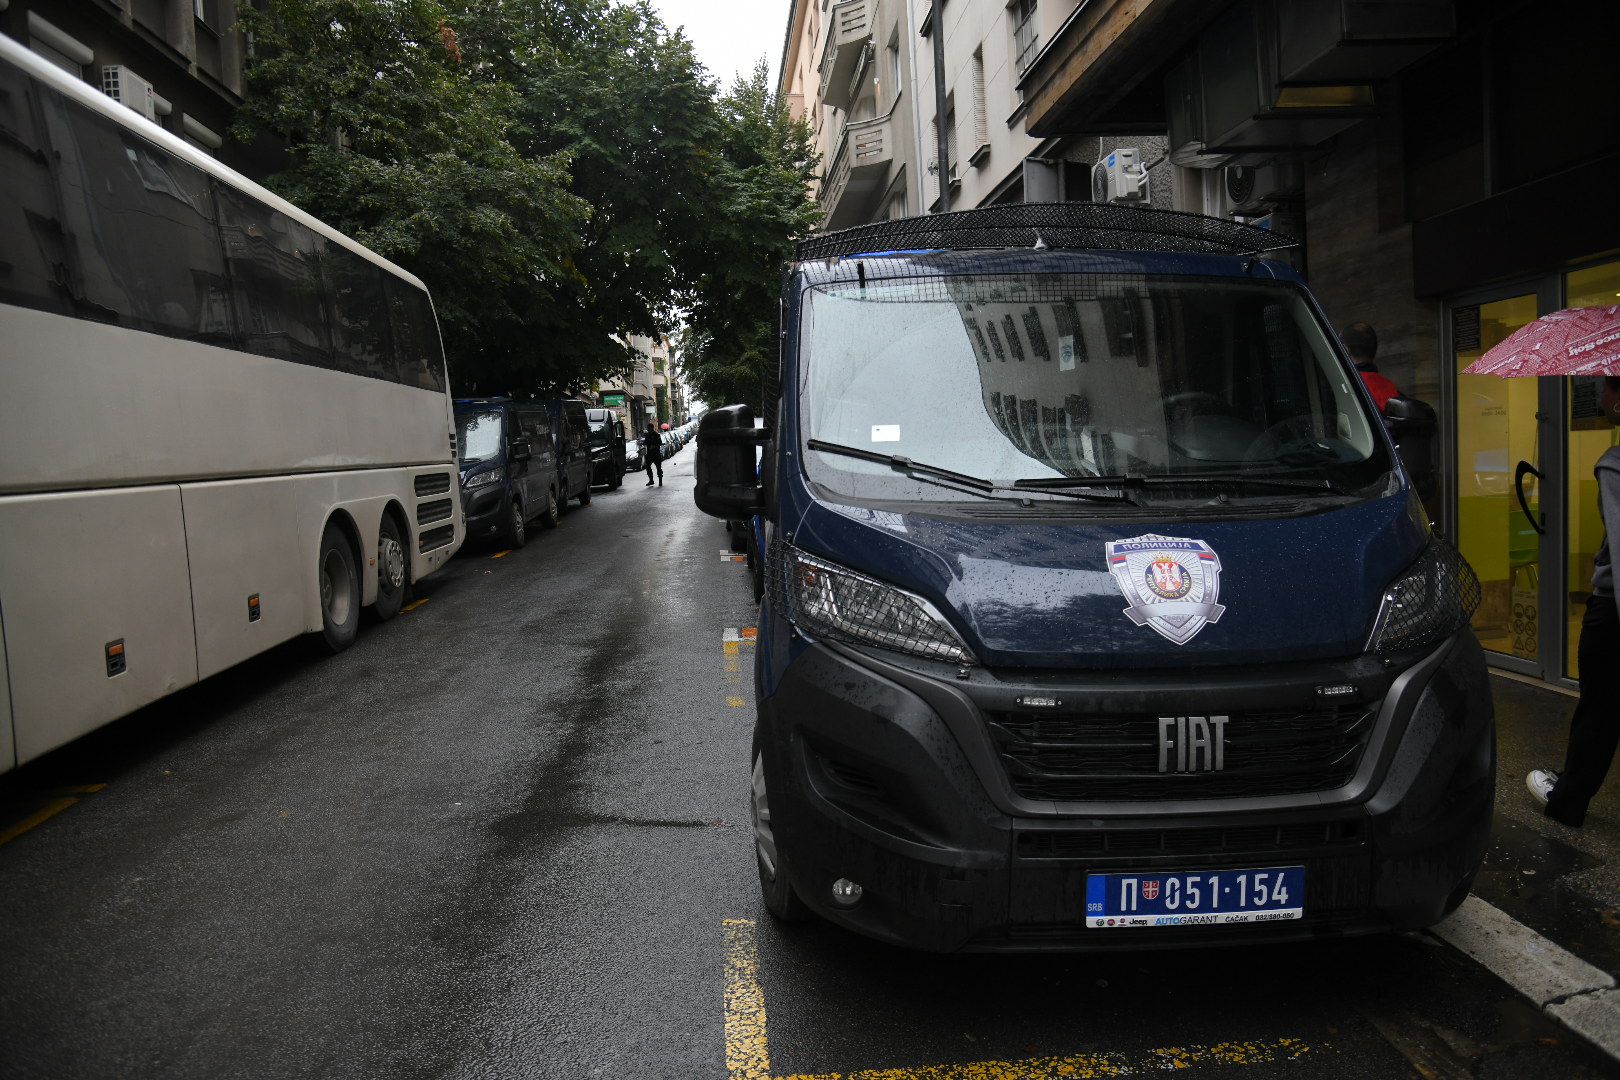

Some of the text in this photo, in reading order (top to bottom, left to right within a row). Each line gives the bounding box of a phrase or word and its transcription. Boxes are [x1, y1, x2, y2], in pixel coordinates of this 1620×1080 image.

[1158, 715, 1229, 773] FIAT
[1087, 902, 1103, 912] SRB
[1129, 918, 1147, 926] Jeep
